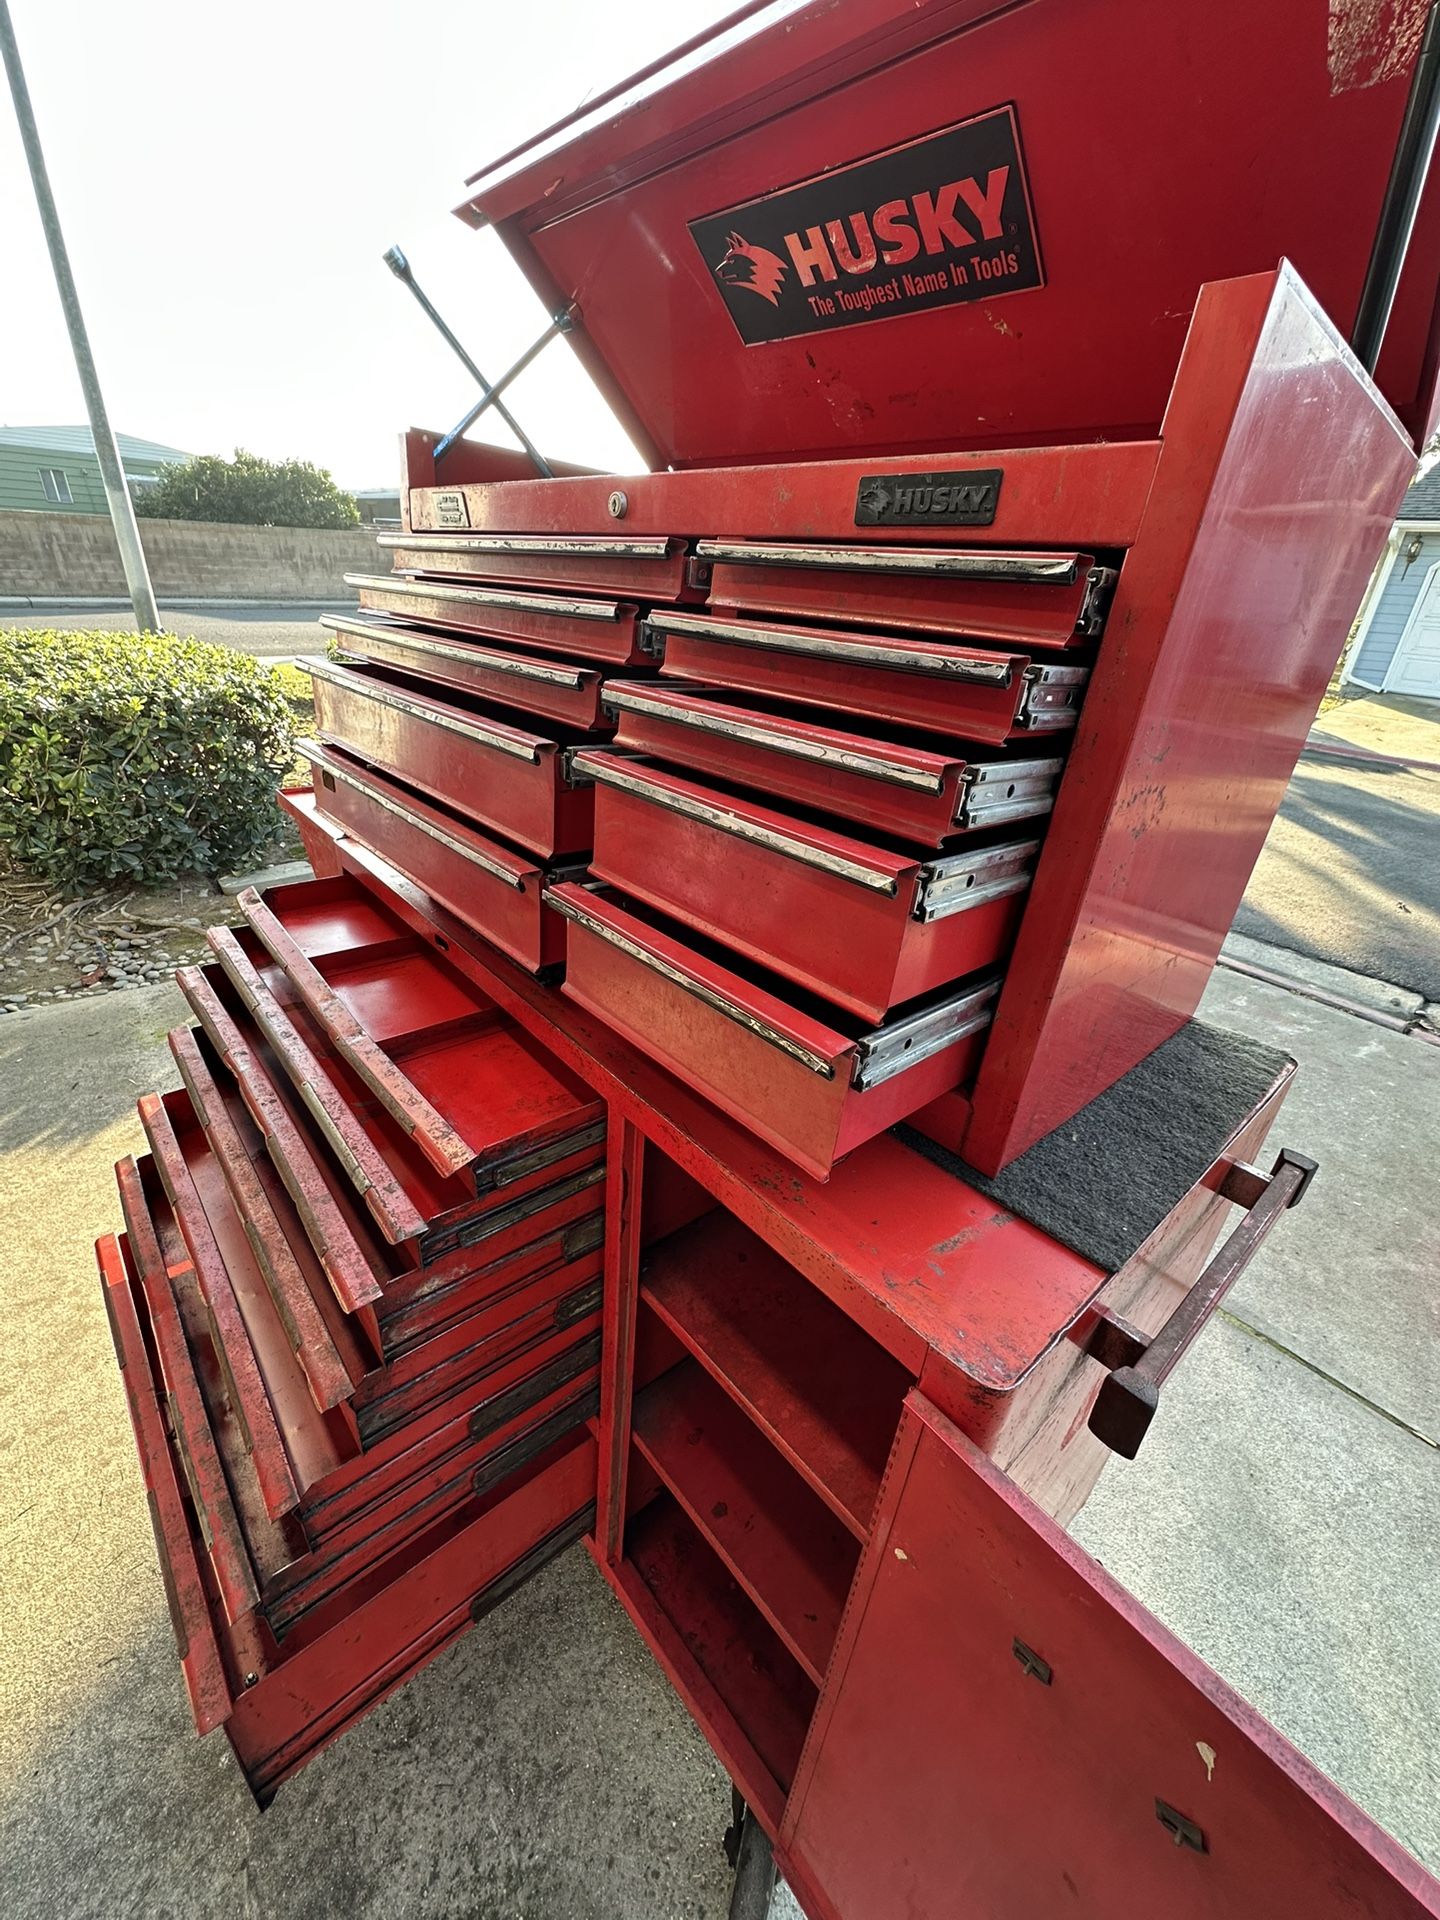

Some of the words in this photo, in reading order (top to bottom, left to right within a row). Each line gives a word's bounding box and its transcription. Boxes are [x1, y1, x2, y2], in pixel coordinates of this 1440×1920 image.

[784, 165, 1010, 287] HUSKY
[808, 296, 835, 317] The
[837, 280, 901, 310] Toughest
[902, 272, 948, 297] Name
[950, 263, 968, 285] In
[973, 251, 1018, 281] Tools
[894, 485, 990, 514] HUSKY
